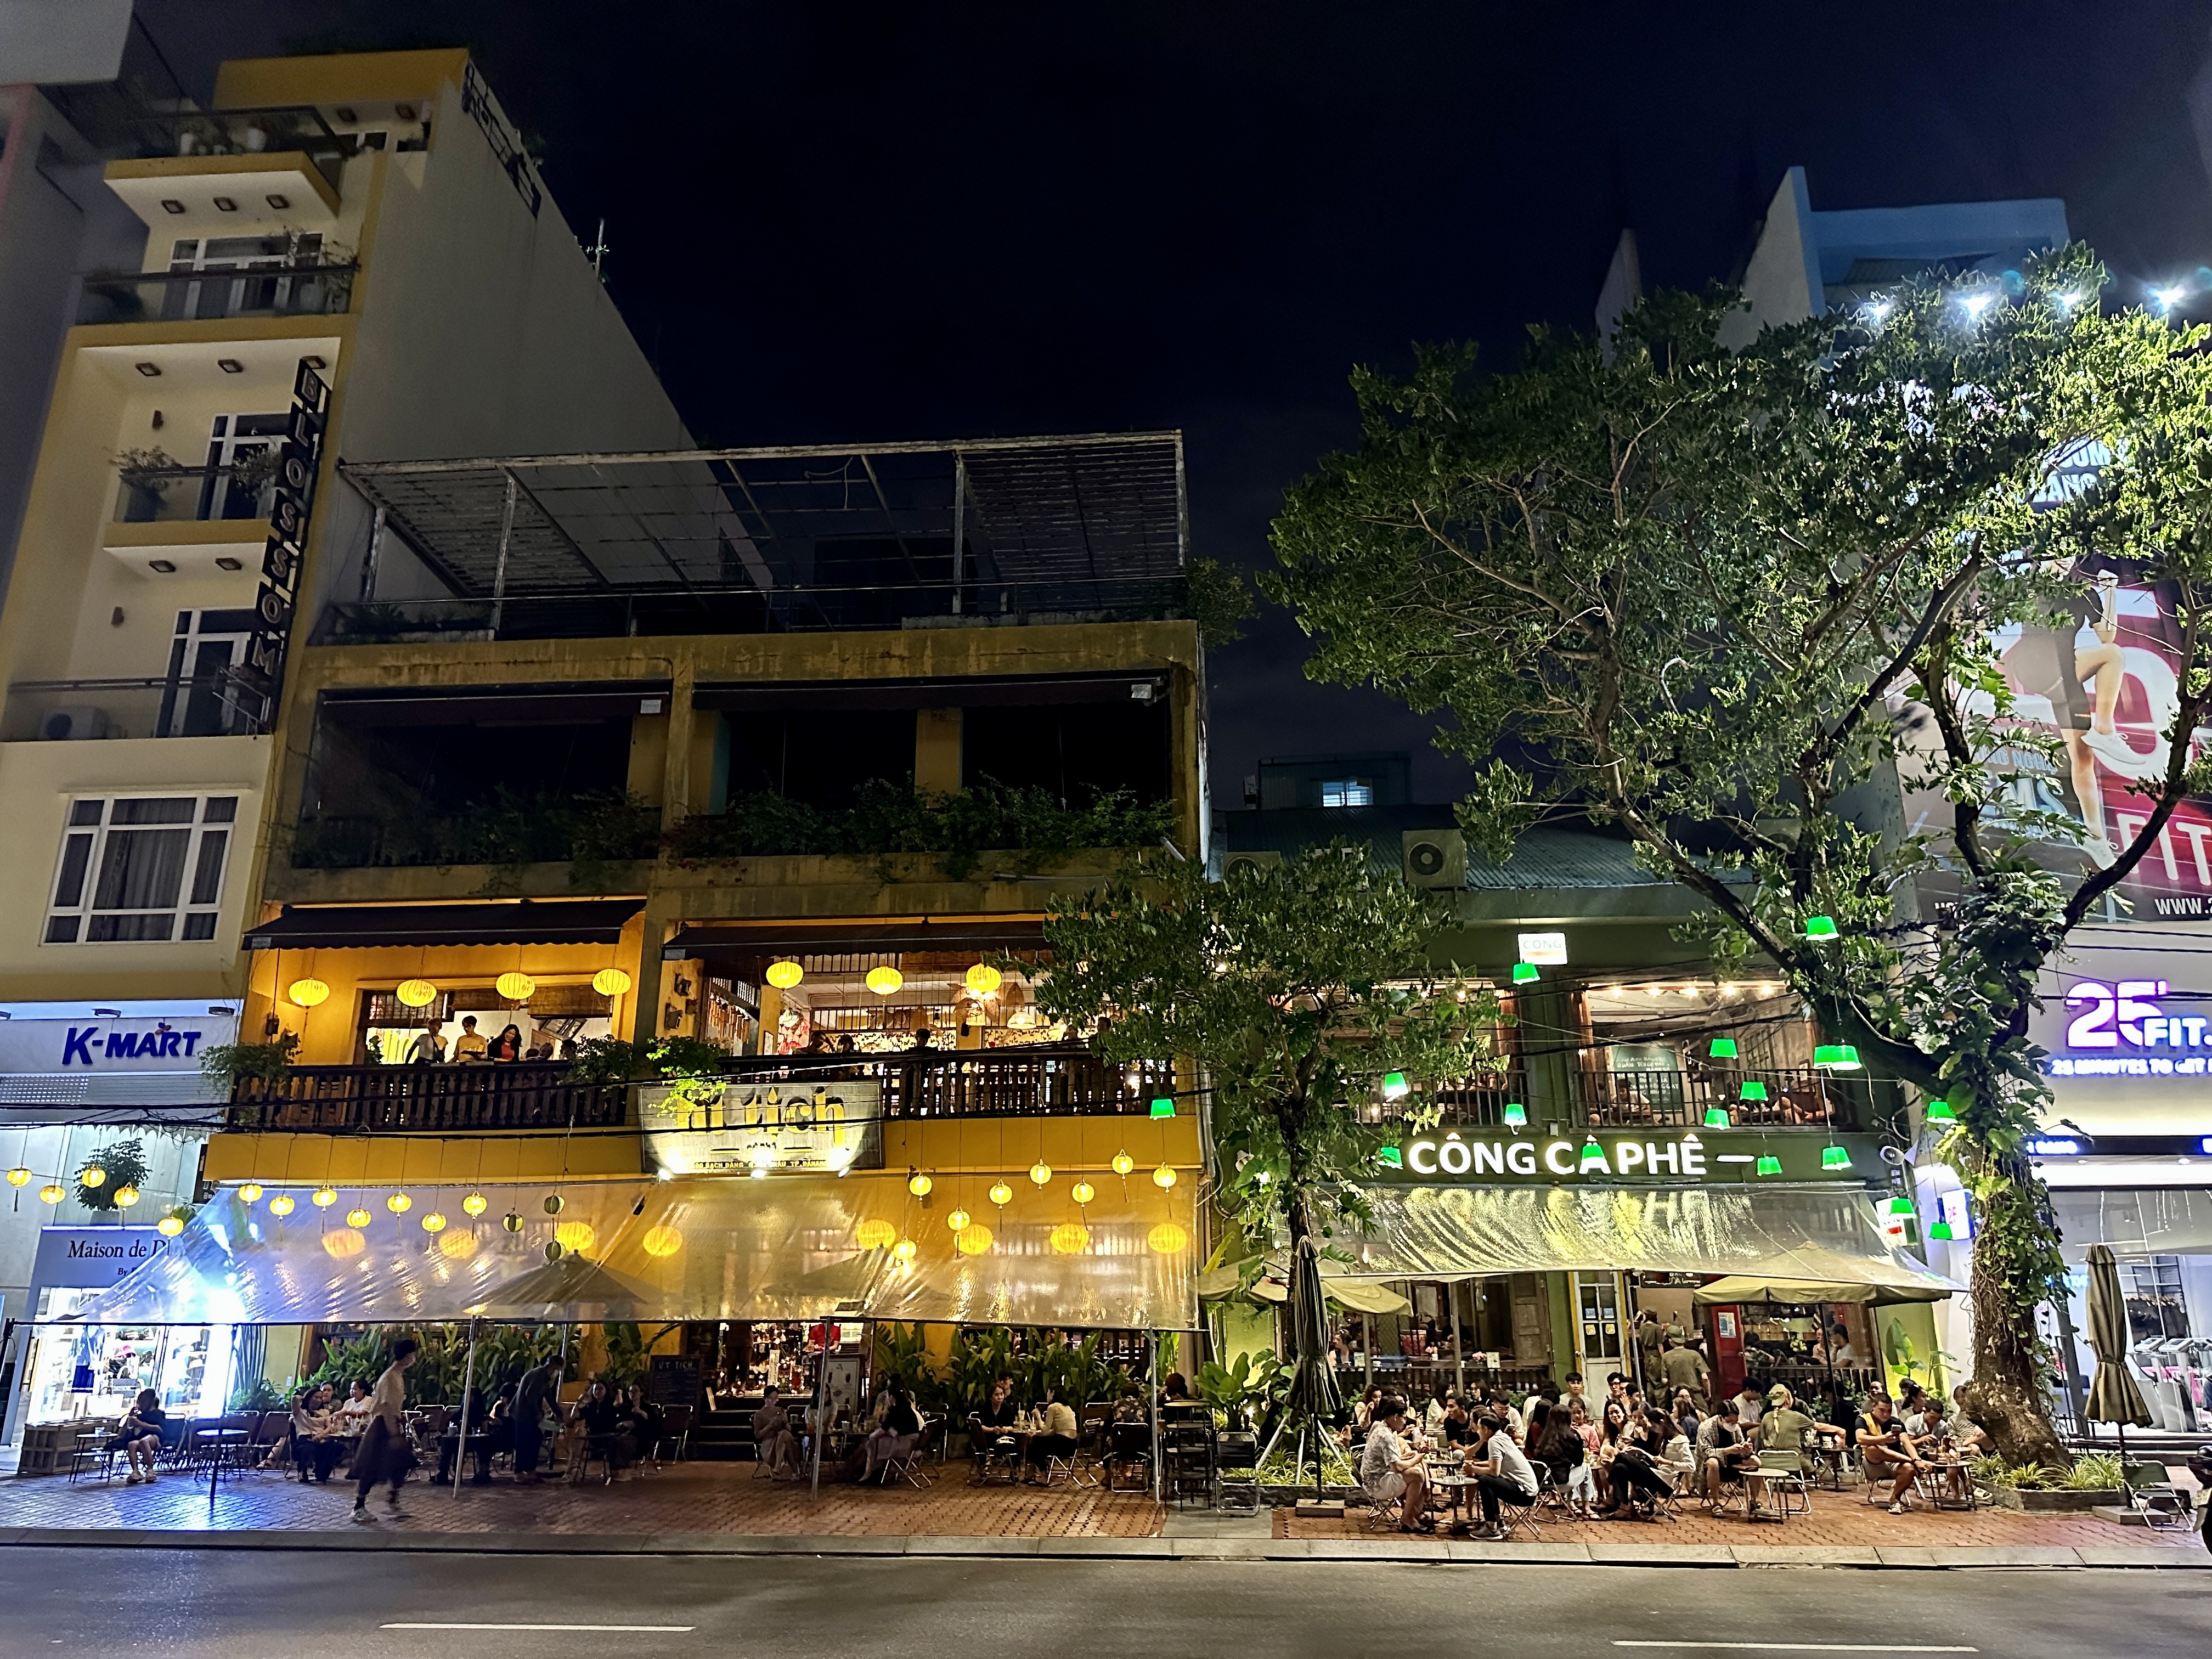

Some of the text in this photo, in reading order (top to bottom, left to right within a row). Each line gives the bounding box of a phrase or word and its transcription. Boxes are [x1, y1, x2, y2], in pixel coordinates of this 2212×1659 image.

[61, 1026, 201, 1065] K-MART
[67, 1240, 123, 1258] Maison
[128, 1239, 147, 1257] de
[117, 1267, 128, 1277] By
